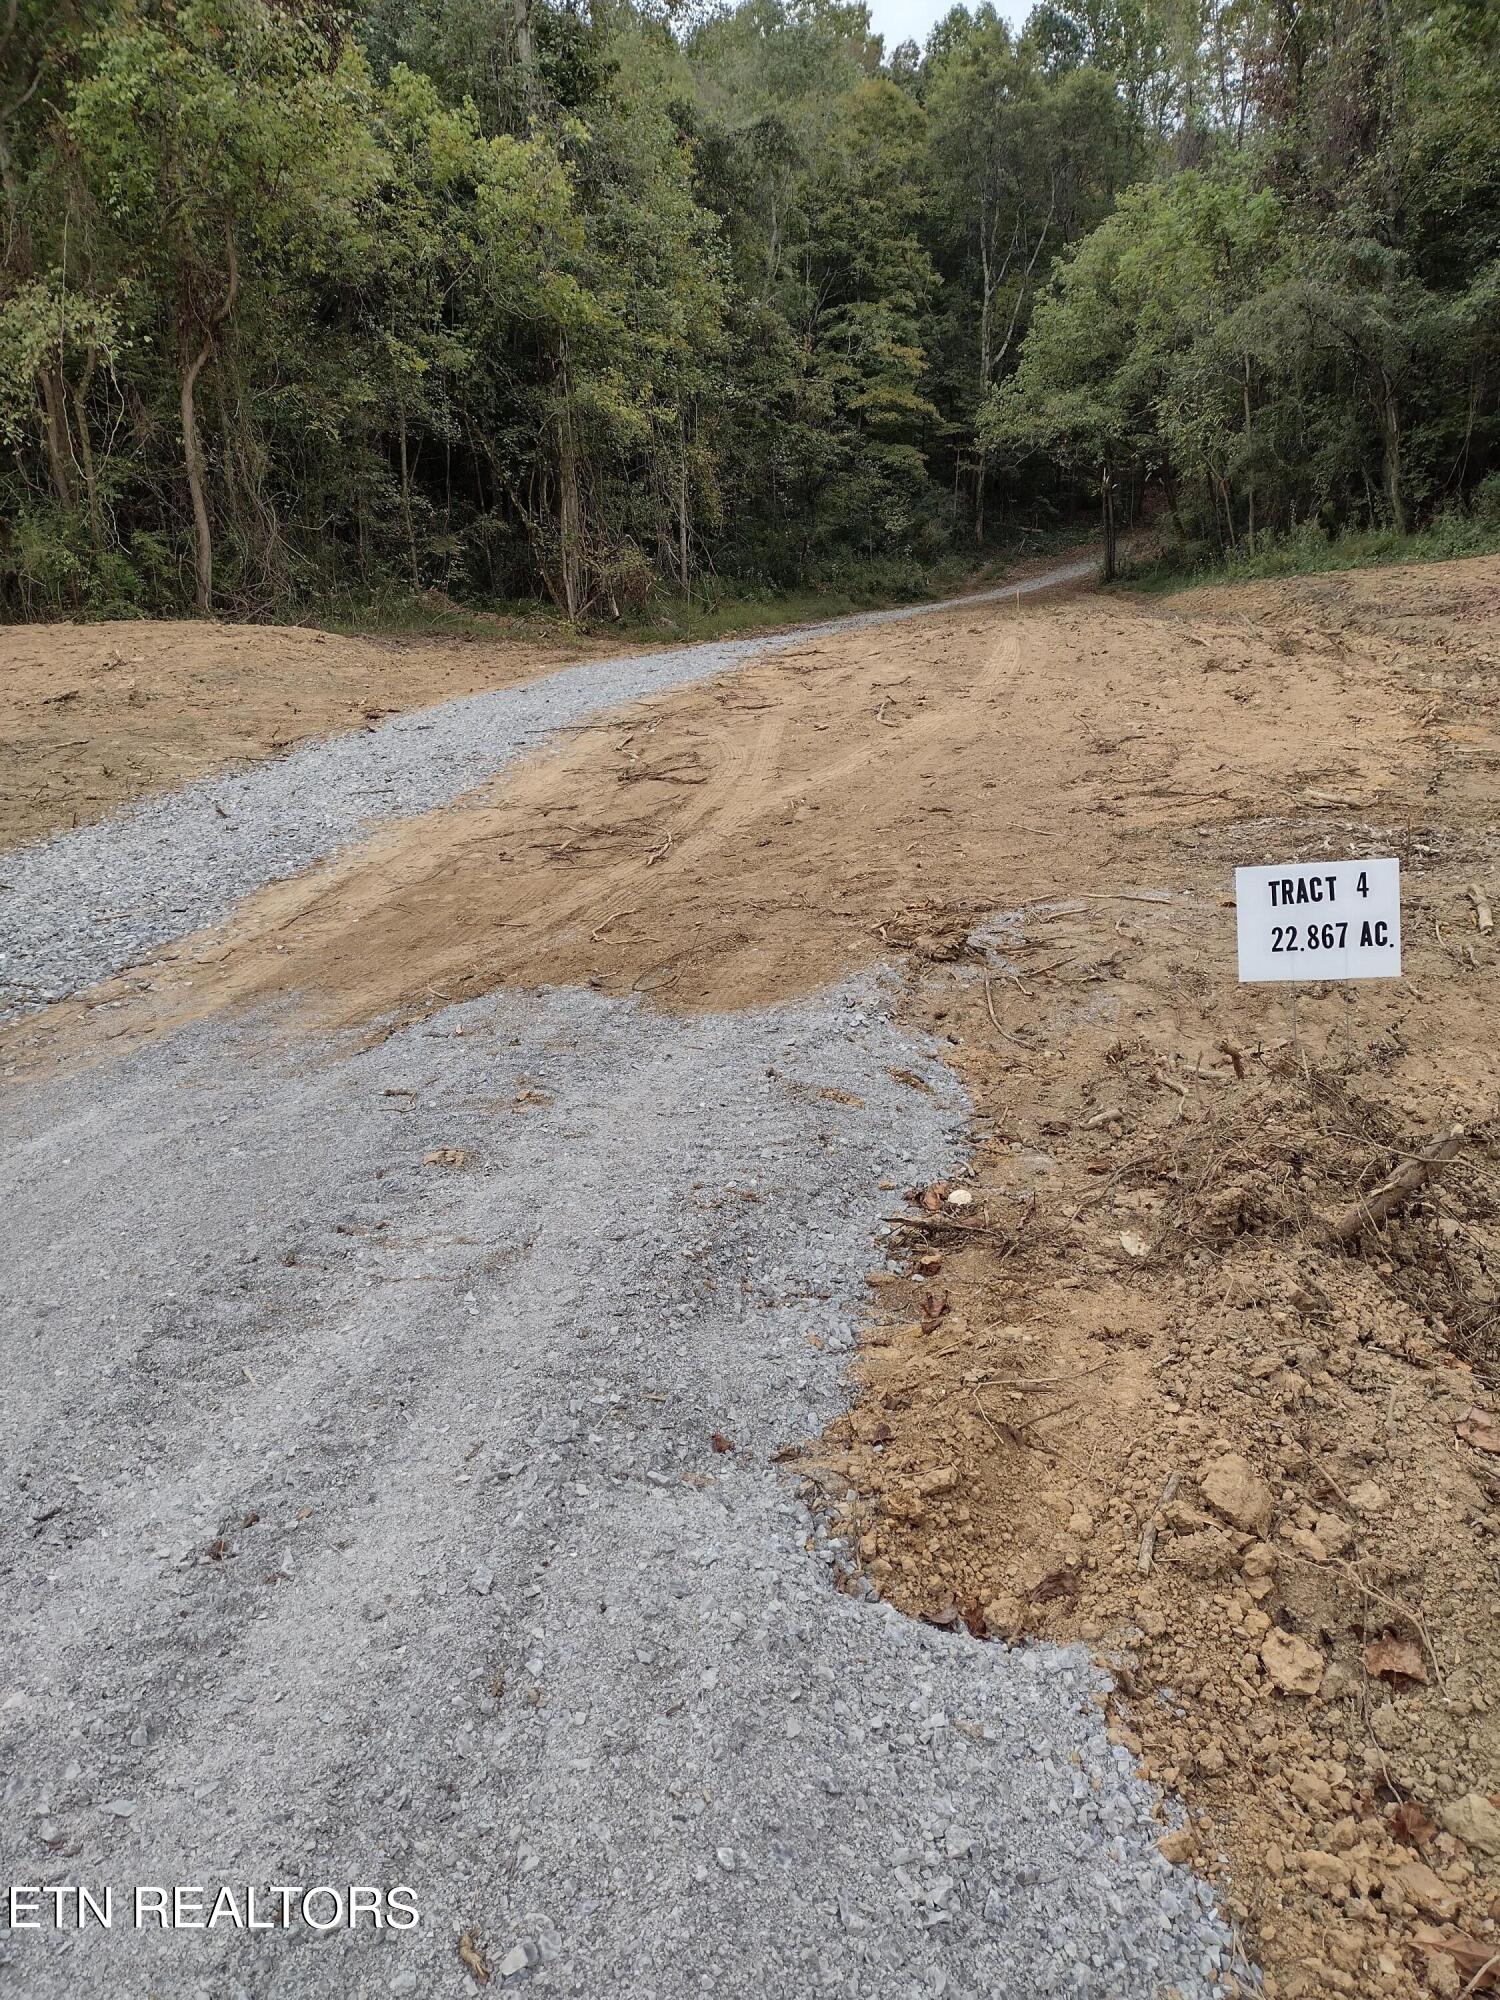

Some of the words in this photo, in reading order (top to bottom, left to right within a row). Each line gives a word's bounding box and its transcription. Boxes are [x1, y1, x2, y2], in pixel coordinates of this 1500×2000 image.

[1268, 876, 1337, 907] TRACT
[1356, 871, 1370, 898] 4
[1271, 922, 1348, 953] 22.867
[1360, 920, 1395, 948] AC.
